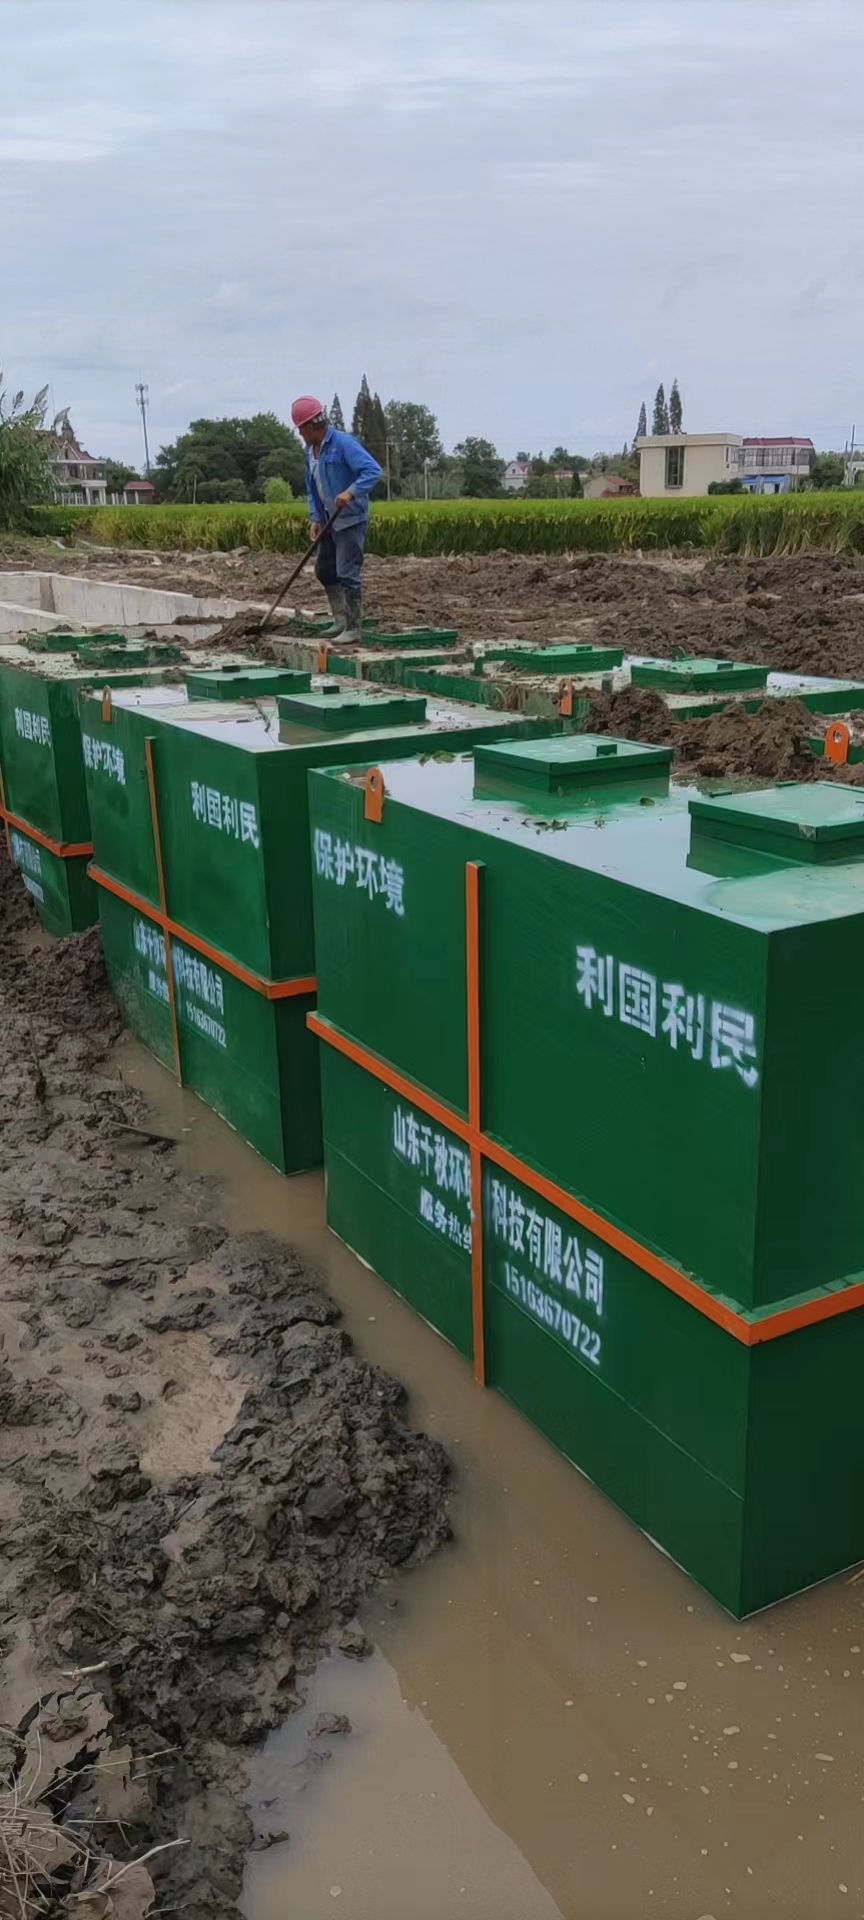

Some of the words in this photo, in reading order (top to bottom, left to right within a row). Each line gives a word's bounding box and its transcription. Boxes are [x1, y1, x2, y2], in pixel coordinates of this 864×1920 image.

[14, 706, 52, 748] 利国利民
[82, 732, 126, 785] 保护环境
[190, 780, 260, 849] 利国利民
[313, 827, 405, 916] 保护环境
[575, 945, 759, 1088] 利国利民
[491, 1178, 605, 1317] 科技有限公司
[504, 1261, 603, 1366] 15163670722
